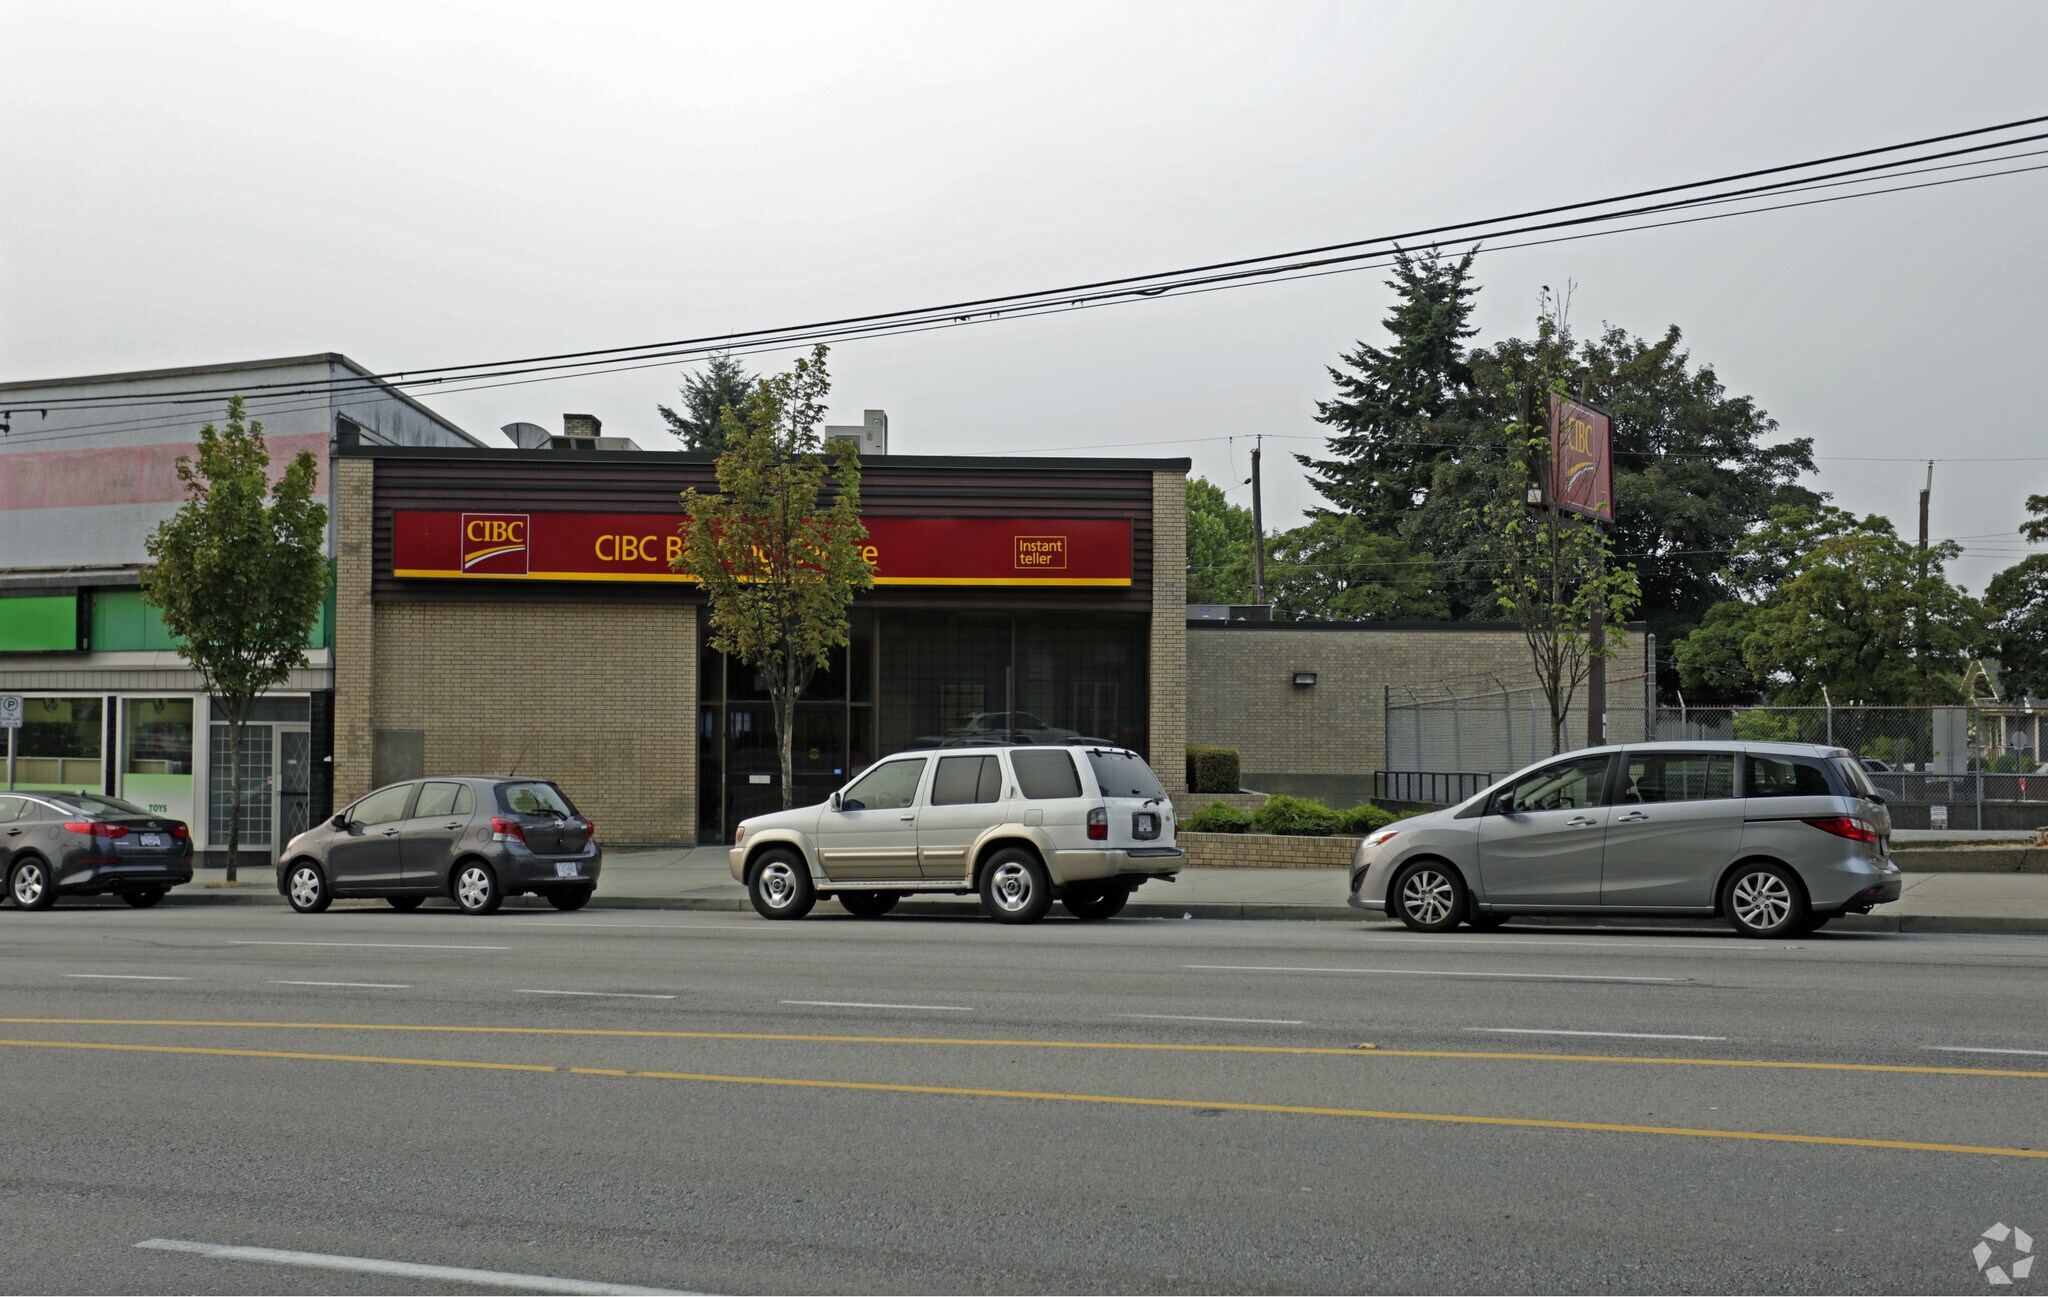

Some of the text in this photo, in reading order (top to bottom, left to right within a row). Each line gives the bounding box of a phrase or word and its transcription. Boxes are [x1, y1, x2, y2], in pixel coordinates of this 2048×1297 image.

[1568, 417, 1592, 456] CIBC
[467, 520, 524, 543] CIBC
[595, 534, 657, 562] CIBC
[1019, 540, 1062, 552] Instant
[1019, 553, 1052, 564] teller
[149, 804, 167, 813] TOYS
